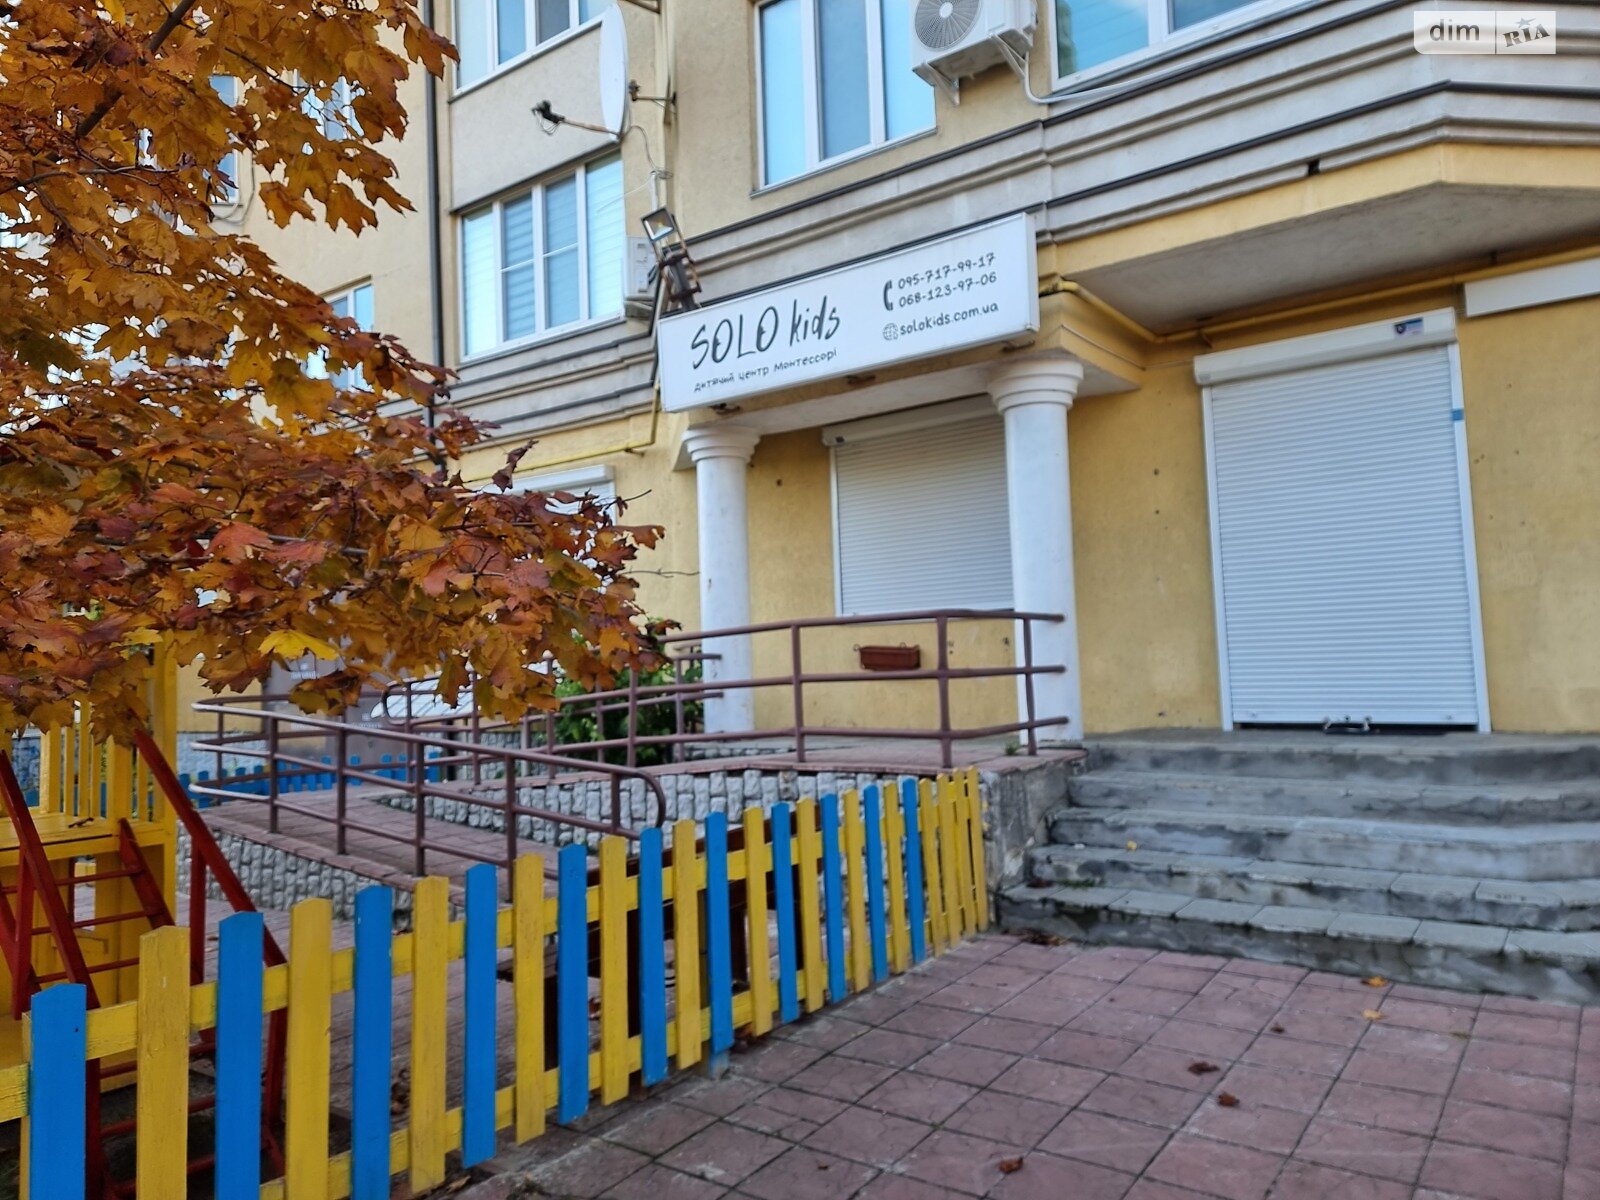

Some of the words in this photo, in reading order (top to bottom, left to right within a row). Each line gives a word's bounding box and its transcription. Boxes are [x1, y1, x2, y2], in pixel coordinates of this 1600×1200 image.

[898, 252, 996, 289] 095-717-99-17
[899, 271, 997, 308] 068-123-97-06
[691, 306, 779, 370] SOLO
[790, 295, 841, 347] kids
[900, 303, 998, 335] solokids.com.ua
[738, 366, 769, 381] центр
[774, 349, 837, 373] Монтессорі
